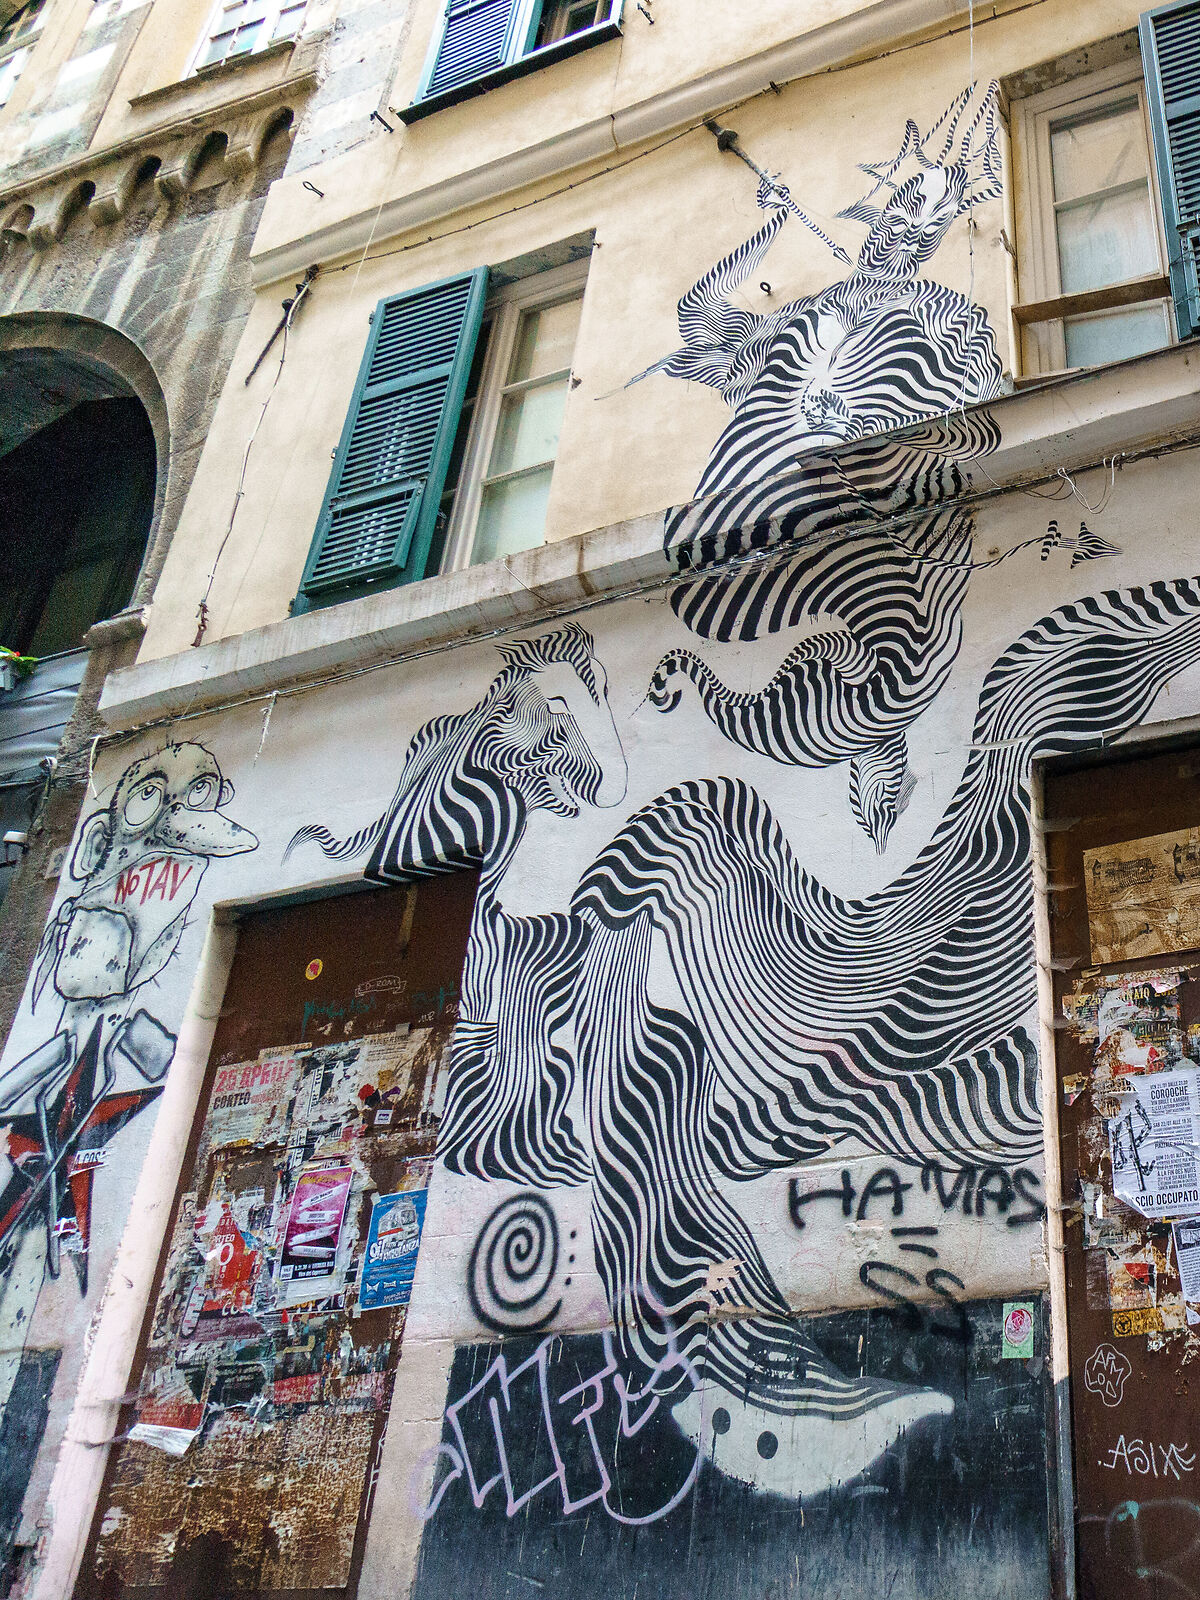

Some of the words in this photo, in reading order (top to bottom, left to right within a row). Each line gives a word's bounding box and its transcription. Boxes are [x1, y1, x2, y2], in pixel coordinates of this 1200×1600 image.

[139, 857, 194, 906] TAV
[240, 1059, 295, 1089] APRILE
[213, 1091, 251, 1110] CORTEO
[1156, 1189, 1199, 1205] OCCUPATO
